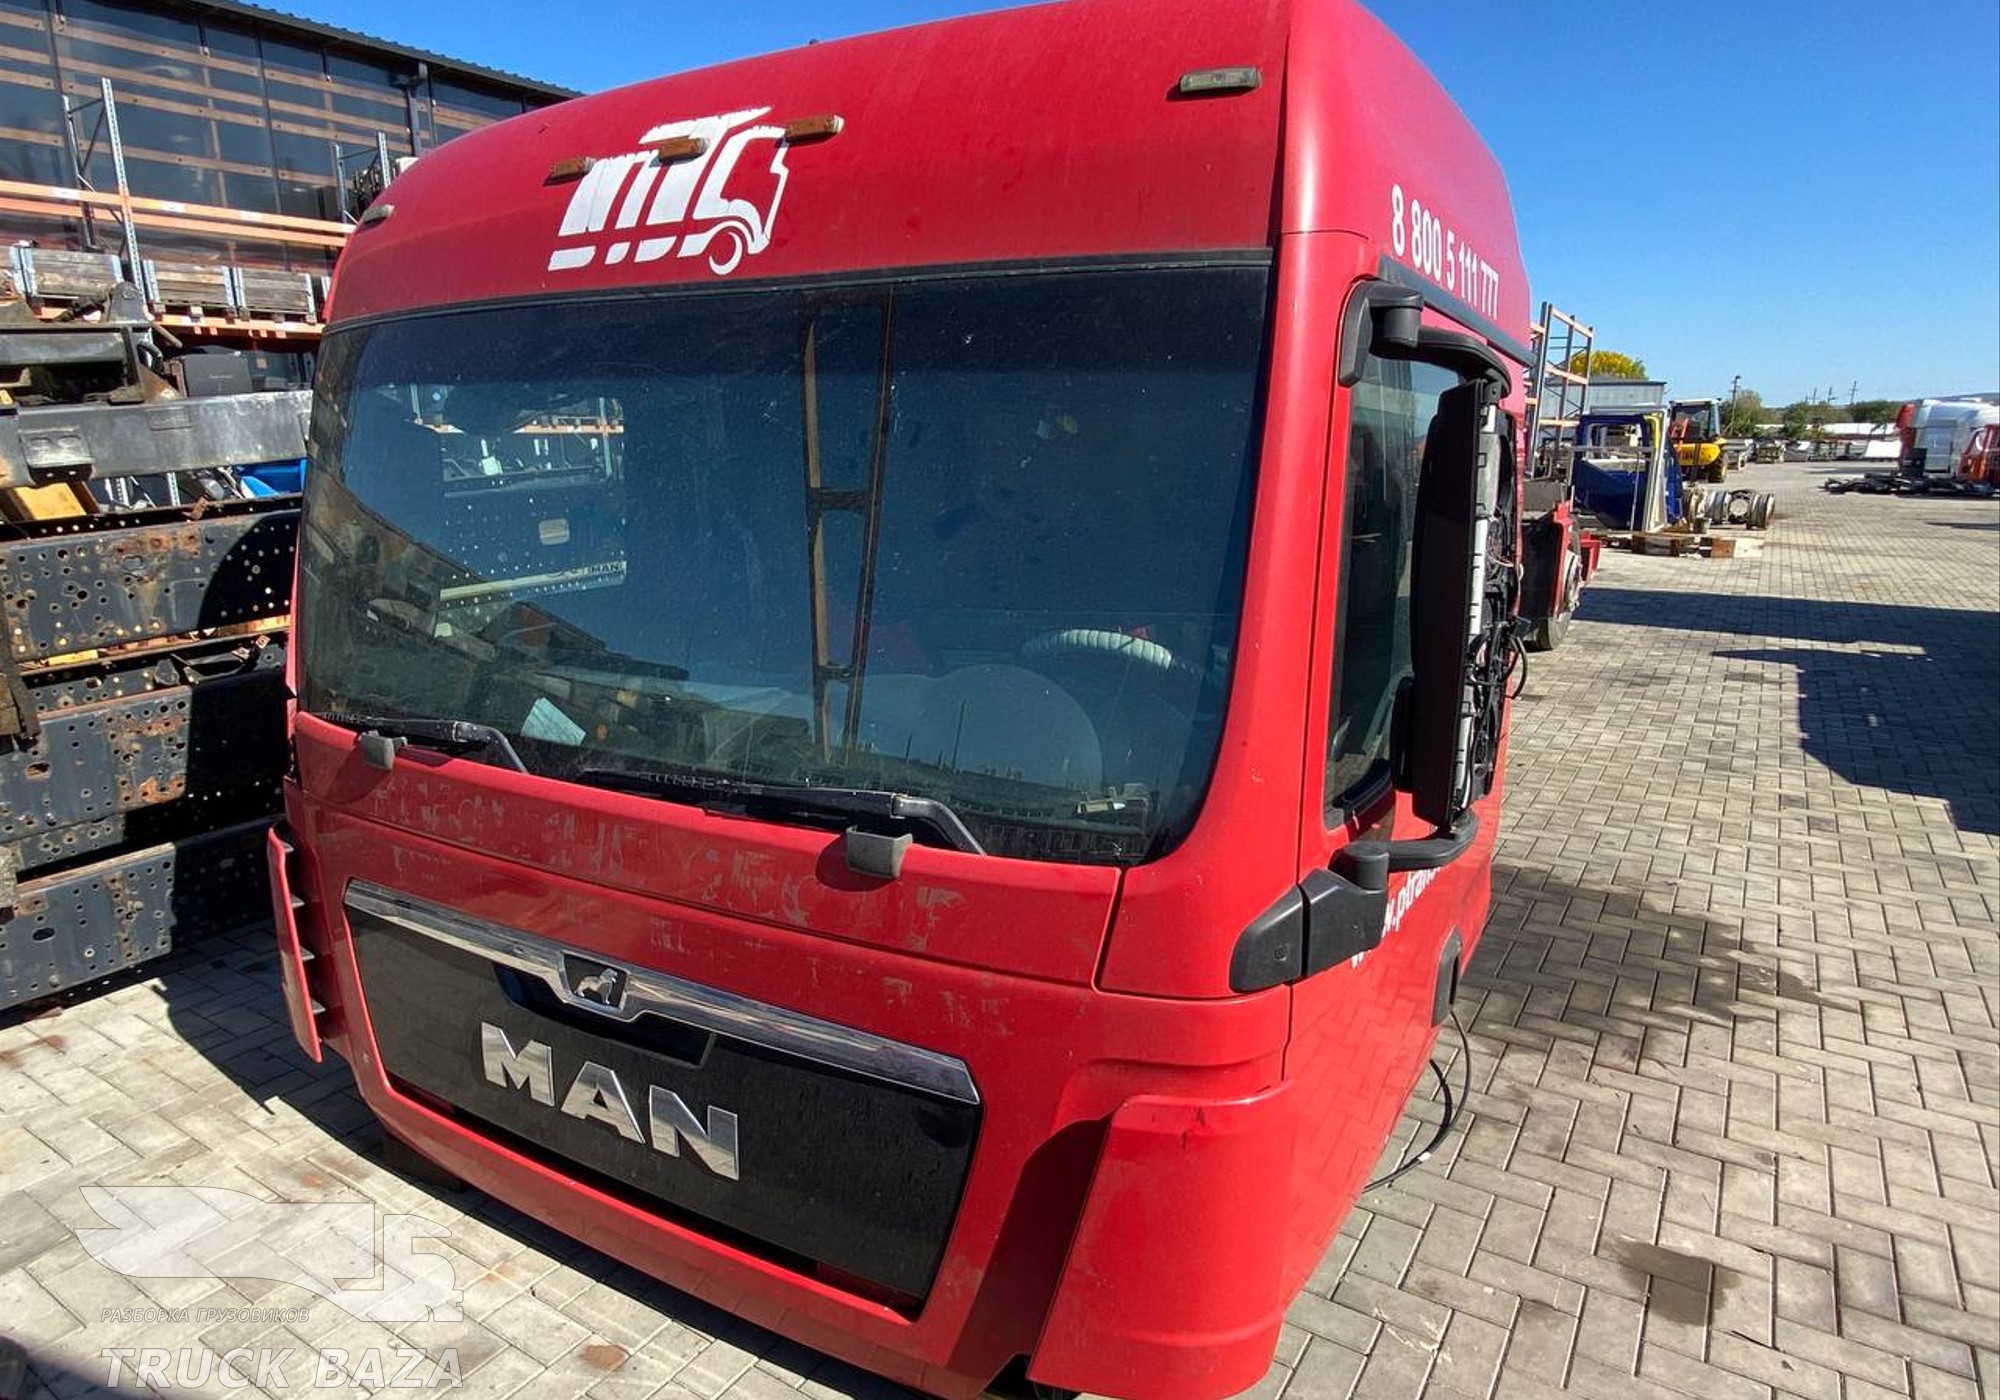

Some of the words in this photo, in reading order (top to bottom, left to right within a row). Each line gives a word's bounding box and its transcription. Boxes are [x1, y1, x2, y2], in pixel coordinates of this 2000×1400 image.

[1392, 184, 1405, 257] 8
[1411, 199, 1442, 281] 800
[1446, 228, 1455, 291] 5
[1459, 241, 1477, 307] 111
[1481, 260, 1499, 320] 777
[481, 1021, 740, 1181] MAN
